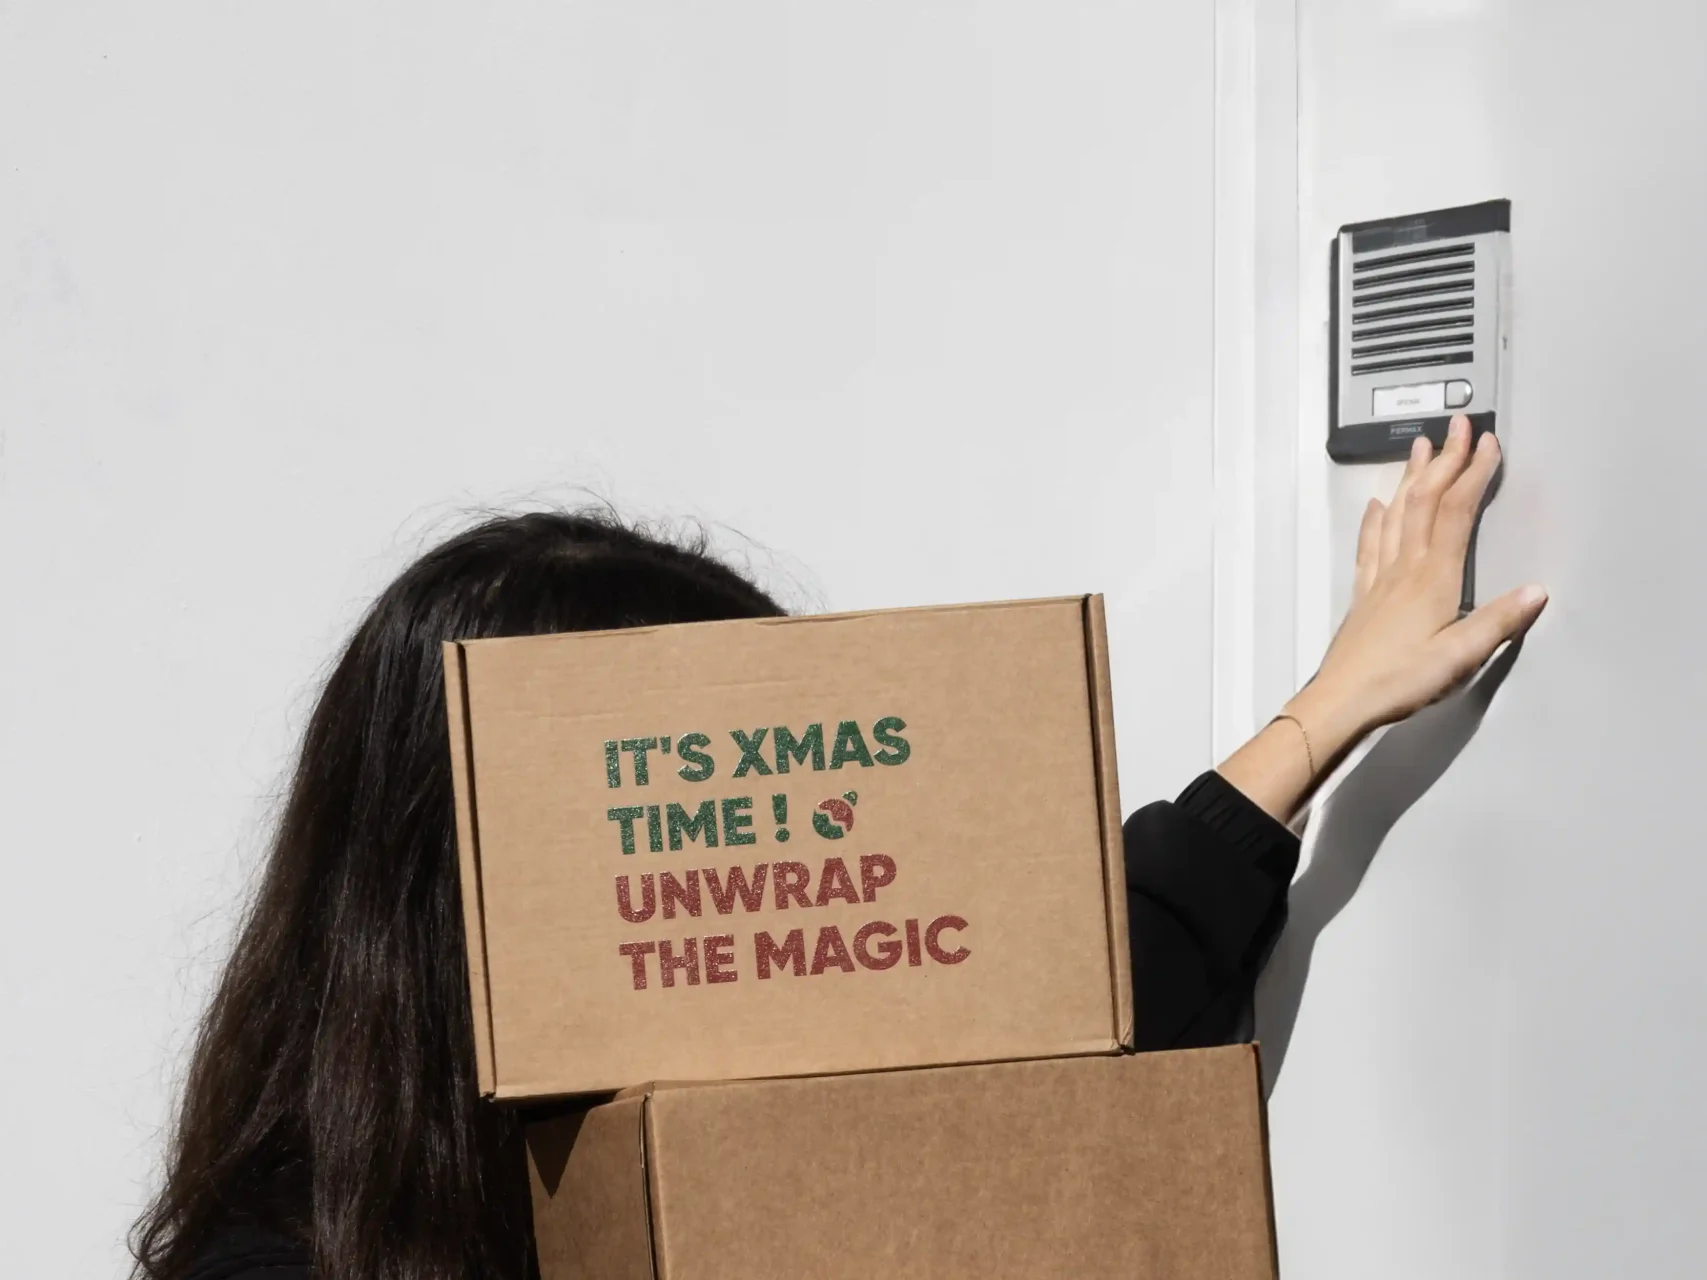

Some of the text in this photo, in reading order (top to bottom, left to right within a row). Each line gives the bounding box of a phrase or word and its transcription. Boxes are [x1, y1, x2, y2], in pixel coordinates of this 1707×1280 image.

[604, 716, 911, 788] IT'S XMAS
[607, 794, 790, 855] TIME !
[615, 854, 897, 923] UNWRAP
[619, 915, 972, 990] THE MAGIC
